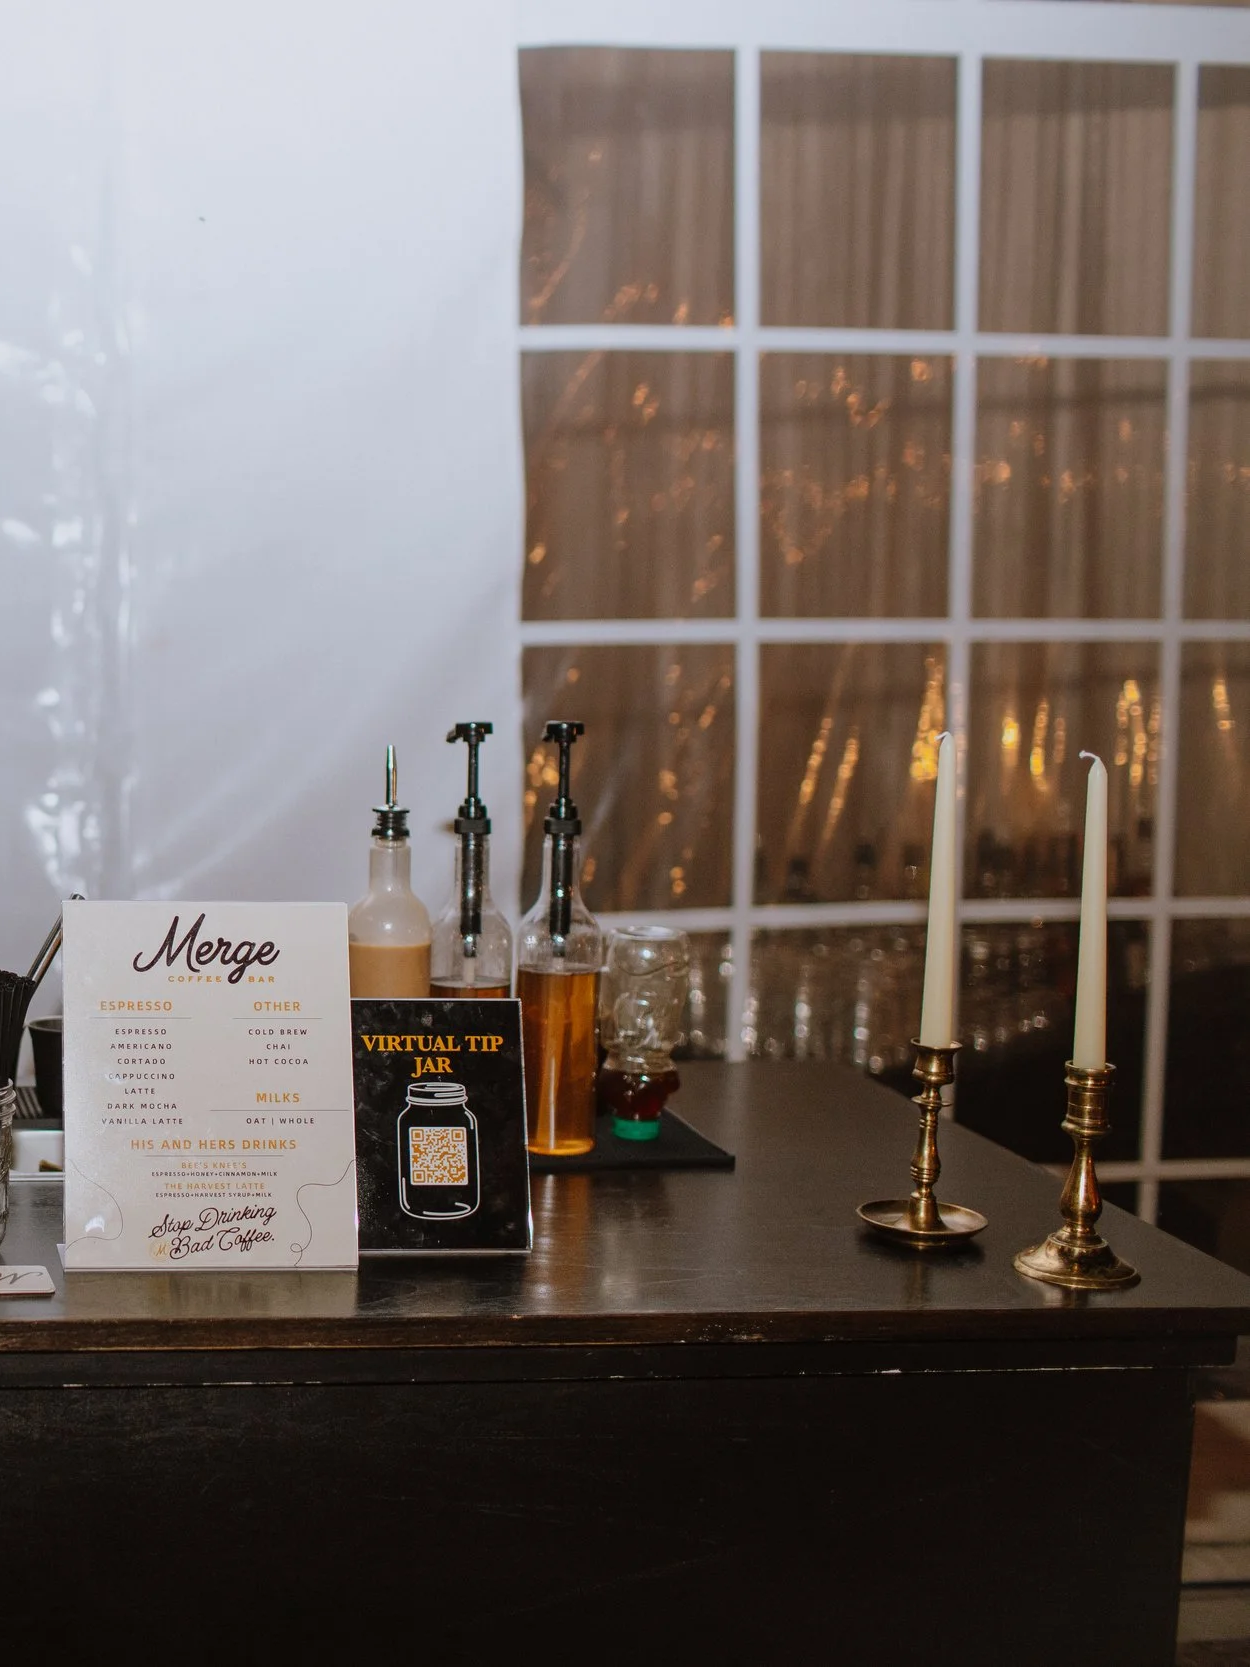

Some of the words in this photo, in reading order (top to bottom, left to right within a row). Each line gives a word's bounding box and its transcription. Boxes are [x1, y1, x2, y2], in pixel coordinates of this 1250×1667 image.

[132, 912, 281, 985] Merge
[168, 975, 222, 983] COFFEE
[248, 975, 275, 983] BAR
[100, 1000, 173, 1012] ESPRESSO
[253, 1001, 301, 1012] OTHER
[115, 1028, 167, 1036] ESPRESSO
[248, 1028, 275, 1036] COLD
[279, 1028, 308, 1036] BREW
[110, 1043, 172, 1051] AMERICANO
[266, 1043, 291, 1051] CHAI
[360, 1035, 461, 1052] VIRTUAL
[464, 1035, 504, 1052] TIP
[410, 1056, 454, 1079] JAR
[108, 1073, 175, 1081] CAPPUCCINO
[256, 1092, 301, 1103] MILKS
[246, 1117, 266, 1125] OAT
[279, 1117, 316, 1125] WHOLE
[130, 1139, 155, 1150] HIS
[160, 1139, 192, 1150] AND
[198, 1139, 236, 1150] HERS
[241, 1139, 297, 1150] DRINKS
[164, 1182, 183, 1190] THE
[187, 1182, 232, 1190] HARVEST
[235, 1182, 266, 1190] LATTE
[148, 1213, 194, 1238] Stop
[194, 1204, 277, 1232] Drinking
[169, 1235, 214, 1260] Bad
[216, 1226, 275, 1253] Coffee.
